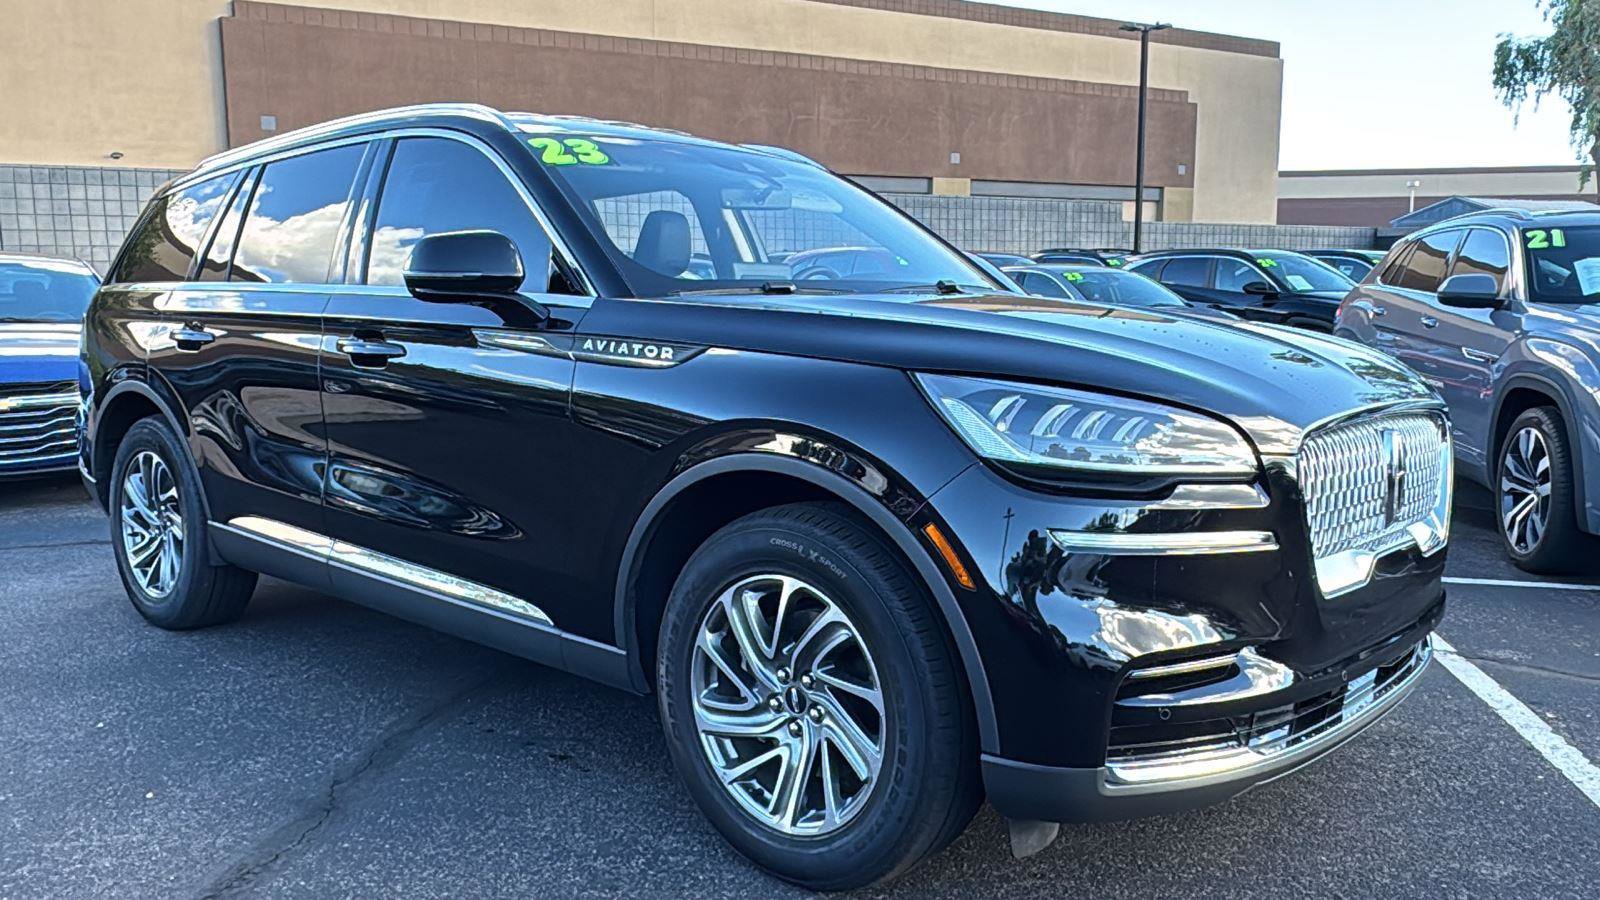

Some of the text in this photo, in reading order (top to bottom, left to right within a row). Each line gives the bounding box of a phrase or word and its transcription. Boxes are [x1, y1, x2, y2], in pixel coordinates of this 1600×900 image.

[527, 137, 609, 165] 23
[1525, 229, 1566, 249] 21
[583, 338, 674, 360] AVIATOR
[818, 556, 848, 580] SPORT
